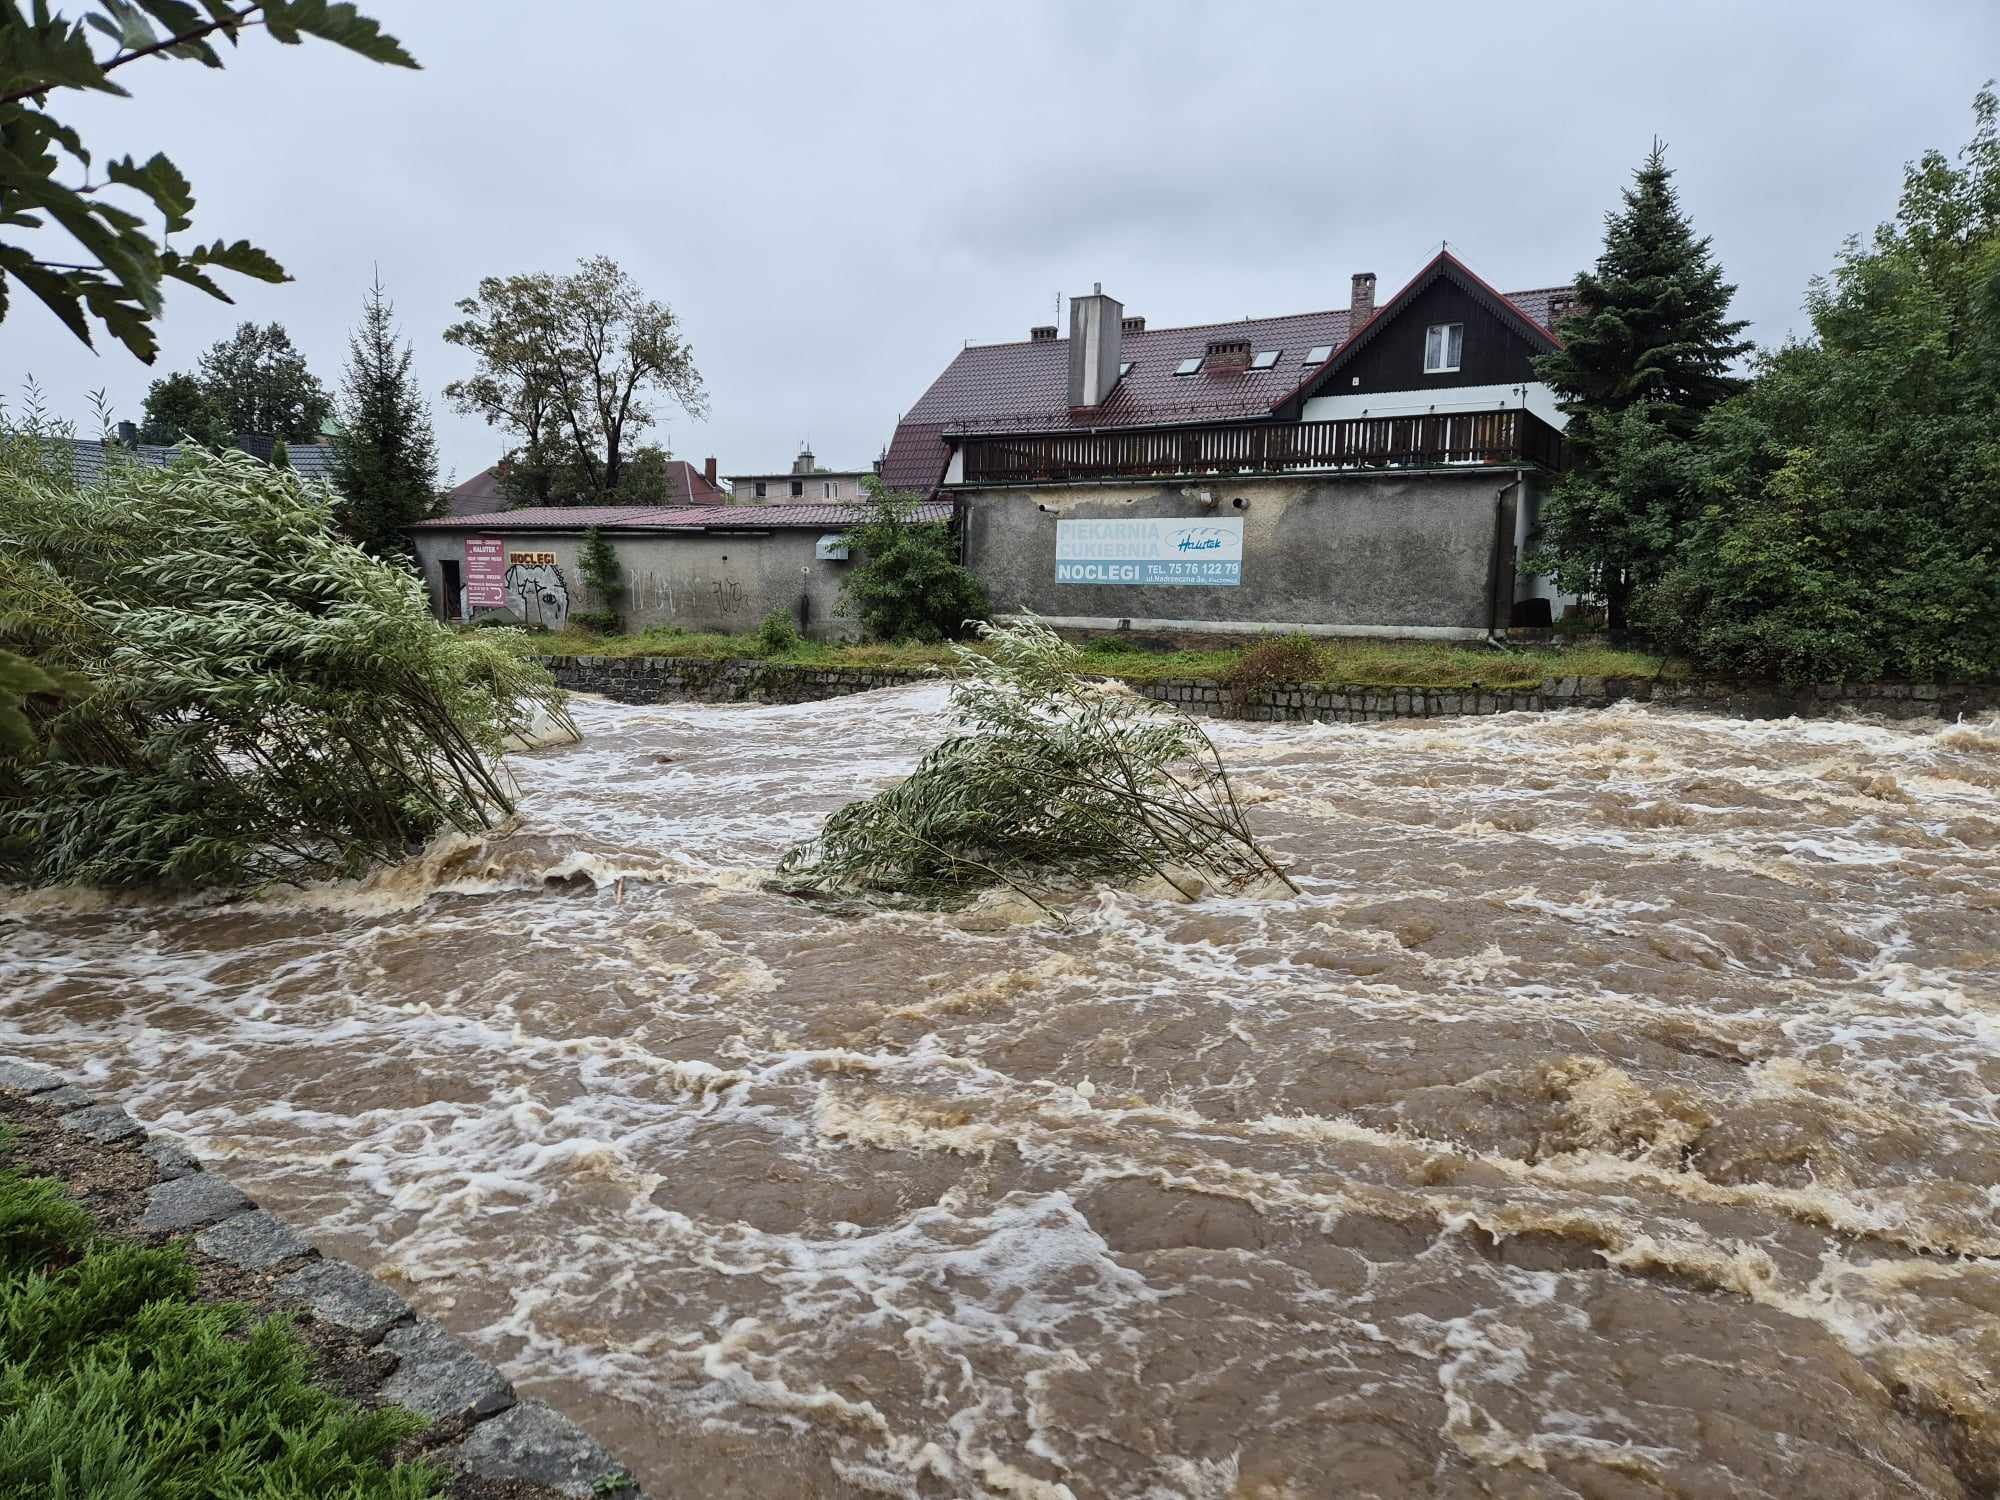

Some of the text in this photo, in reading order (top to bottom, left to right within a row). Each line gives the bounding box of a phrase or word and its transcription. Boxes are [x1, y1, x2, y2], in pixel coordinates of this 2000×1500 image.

[1060, 522, 1160, 540] PIEKARNIA
[1060, 543, 1160, 558] CUKIERNIA
[510, 553, 554, 564] NOCLEGI
[1058, 564, 1140, 580] NOCLEGI
[1147, 563, 1239, 574] TEL. 75 76 122 79
